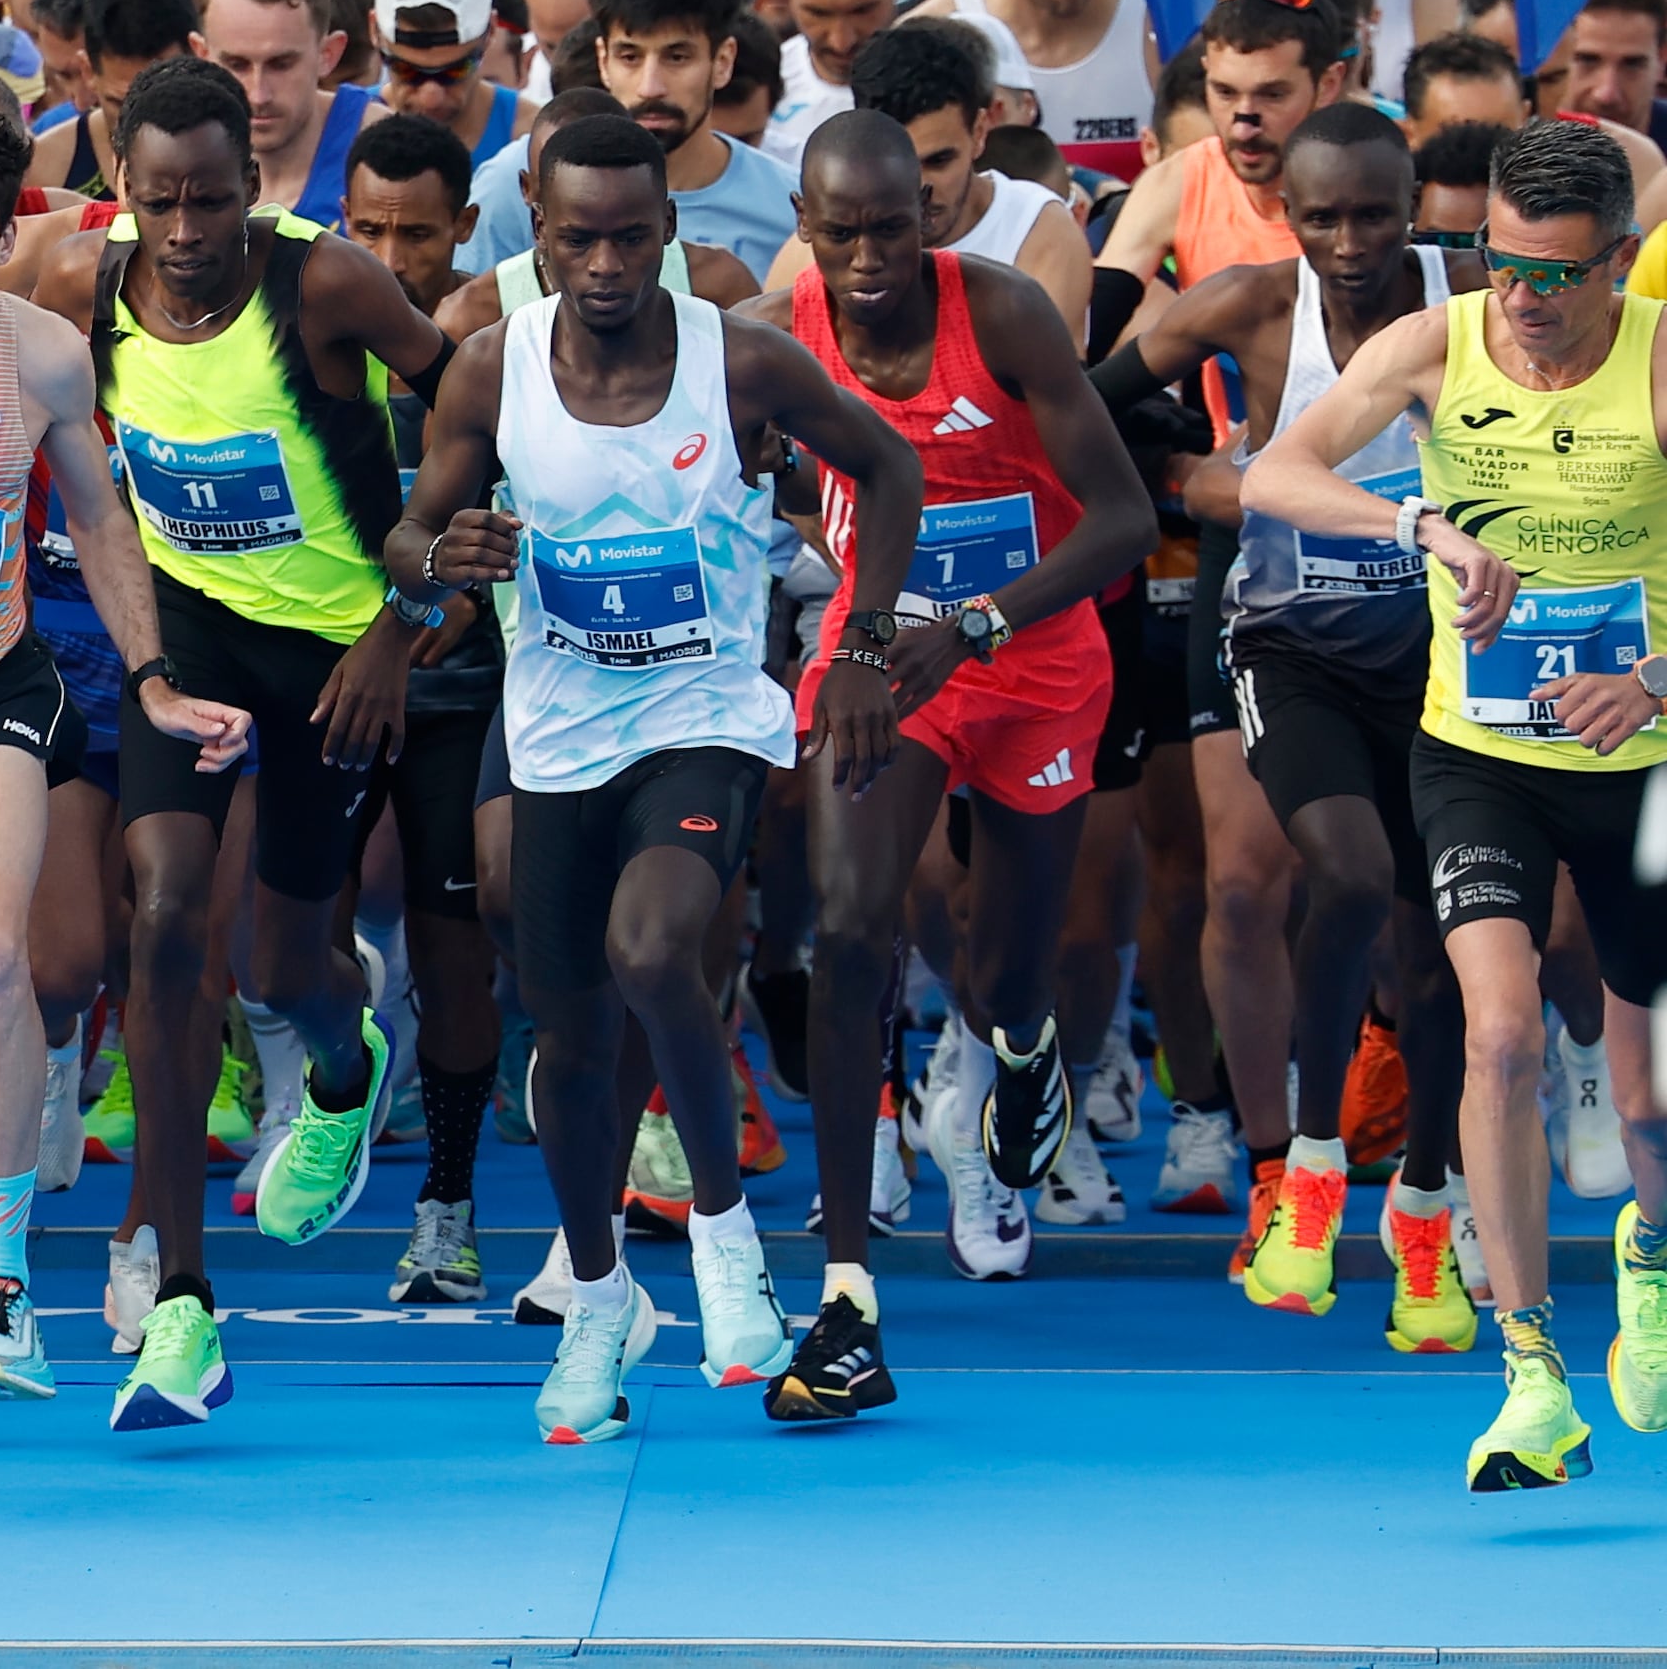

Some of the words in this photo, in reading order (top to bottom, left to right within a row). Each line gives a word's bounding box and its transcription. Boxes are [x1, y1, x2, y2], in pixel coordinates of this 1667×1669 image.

[1475, 446, 1505, 458] BAR
[1606, 443, 1633, 452] Reyes
[184, 448, 247, 465] Movistar
[1453, 453, 1529, 471] SALVADOR
[1473, 470, 1505, 480] 1967
[1556, 461, 1637, 472] BERKSHIRE
[1559, 472, 1635, 484] HATHAWAY
[182, 481, 218, 508] 11
[158, 514, 270, 538] THEOPHILUS
[936, 513, 998, 530] Movistar
[1517, 513, 1618, 535] CLÍNICA
[250, 534, 294, 548] MADRID
[1518, 527, 1650, 554] MENORCA
[600, 545, 664, 561] Movistar
[936, 552, 954, 584] 7
[602, 585, 625, 615] 4
[1547, 603, 1611, 618] Movistar
[586, 631, 657, 651] ISMAEL
[659, 645, 703, 661] MADRID
[1535, 644, 1576, 679] 21
[2, 718, 40, 746] HOKA
[1458, 845, 1508, 857] CLÍNICA
[1458, 854, 1523, 871] MENORCA
